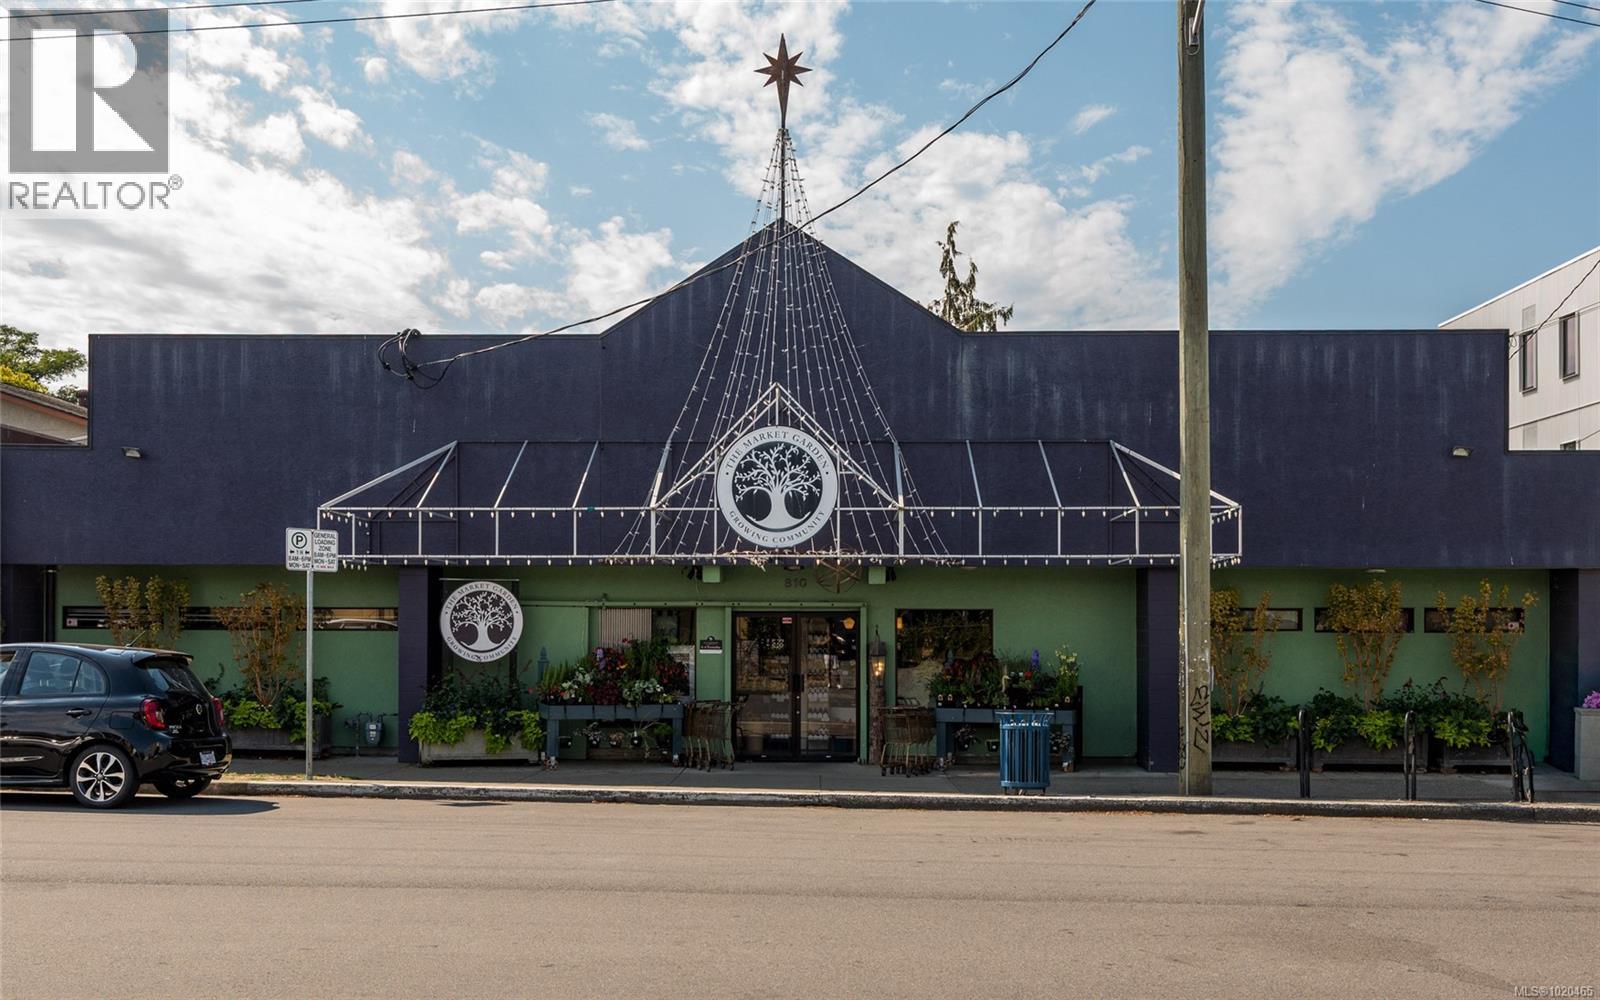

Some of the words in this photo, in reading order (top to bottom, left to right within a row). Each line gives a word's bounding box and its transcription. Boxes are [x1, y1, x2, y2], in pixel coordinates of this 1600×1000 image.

[726, 447, 744, 470] THE
[744, 431, 788, 449] MARKET
[792, 434, 829, 469] GARDEN
[296, 535, 304, 545] P
[729, 510, 769, 543] GROWING
[772, 511, 825, 544] COMMUNITY
[784, 578, 807, 588] 810
[447, 596, 457, 610] THE
[458, 583, 490, 595] MARKET
[492, 585, 519, 610] GARDEN
[446, 636, 475, 660] GROWING
[478, 636, 517, 661] COMMUNITY
